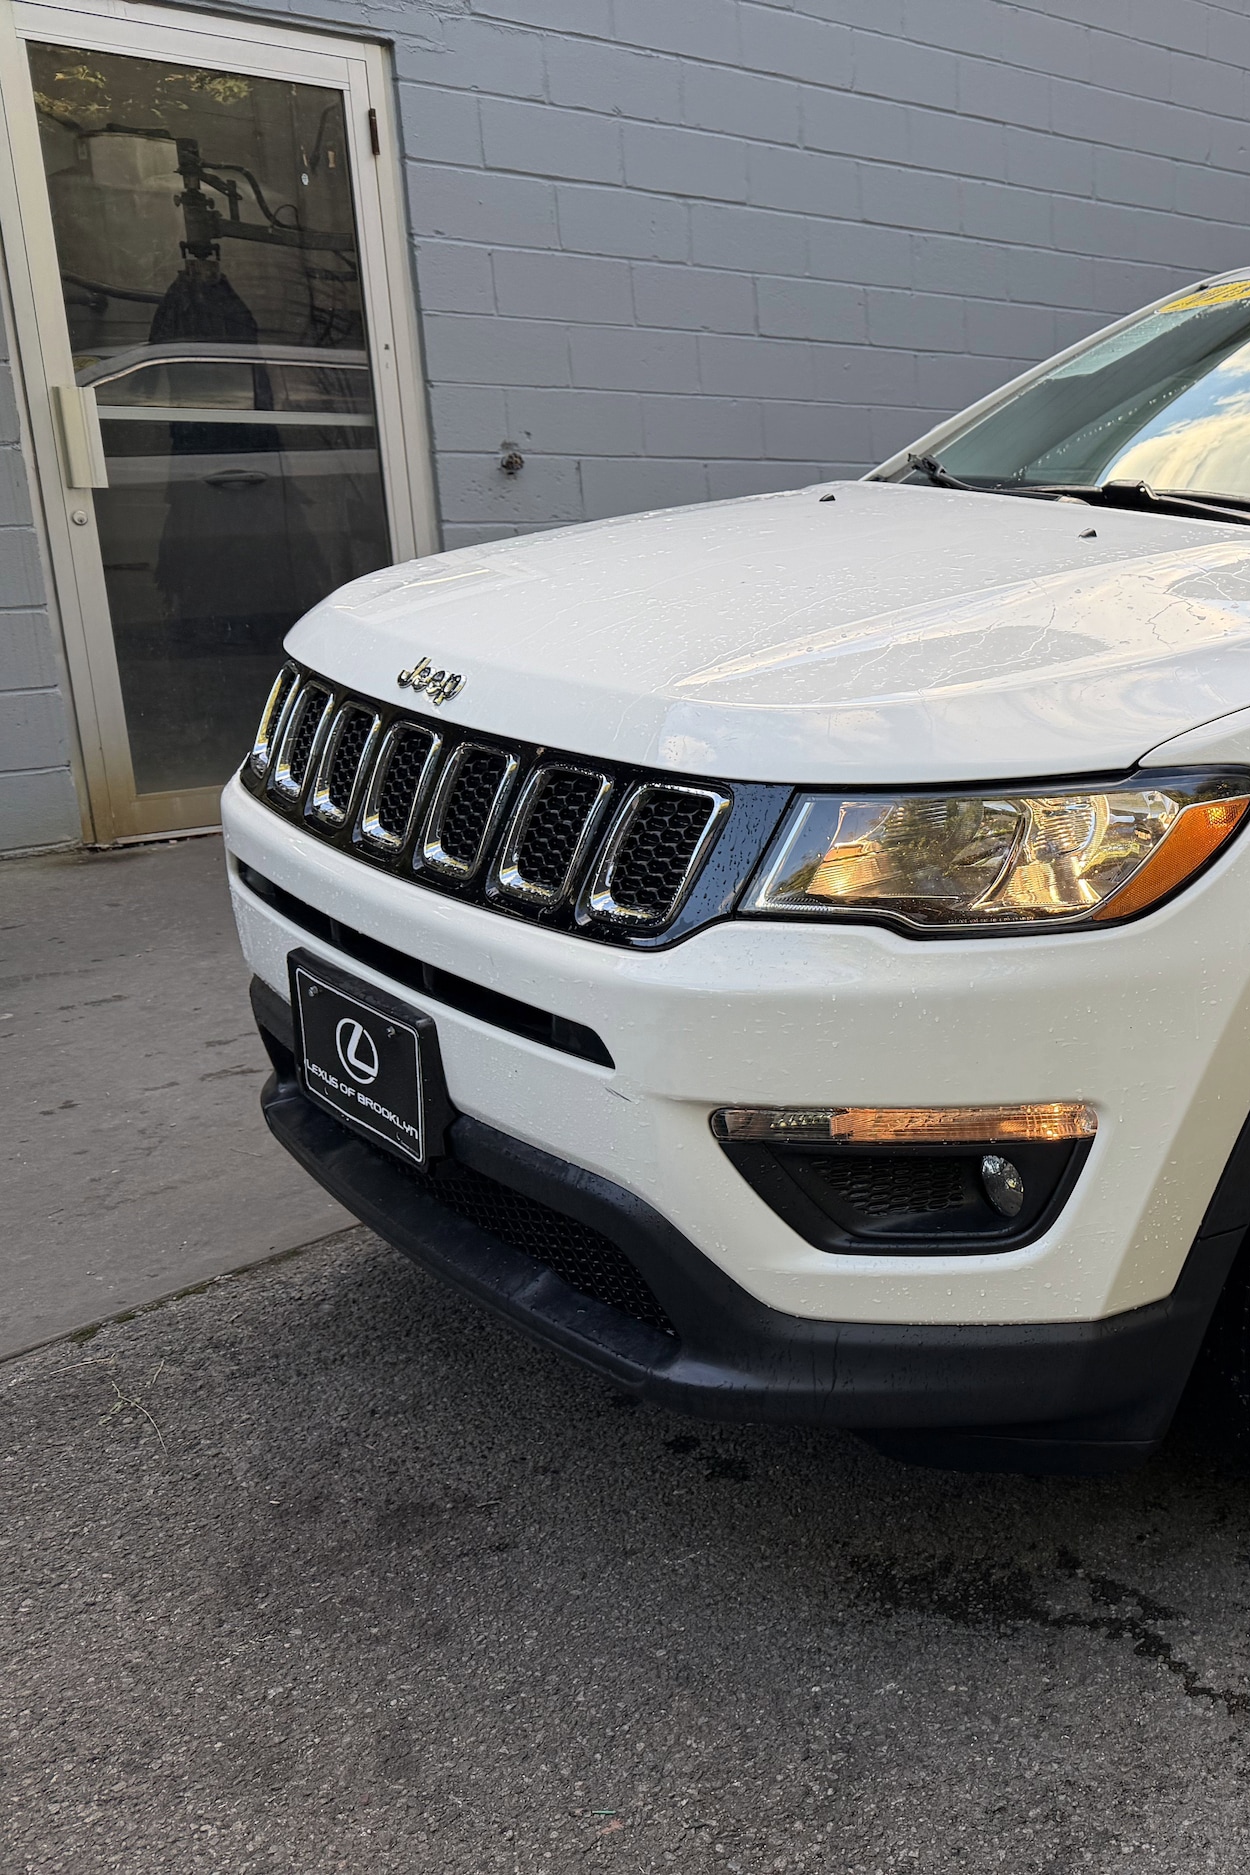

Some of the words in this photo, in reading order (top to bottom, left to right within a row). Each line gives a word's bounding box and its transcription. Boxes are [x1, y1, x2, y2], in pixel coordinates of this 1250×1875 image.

[397, 656, 466, 706] Jeep
[306, 1058, 338, 1089] LEXUS
[339, 1082, 356, 1097] OF
